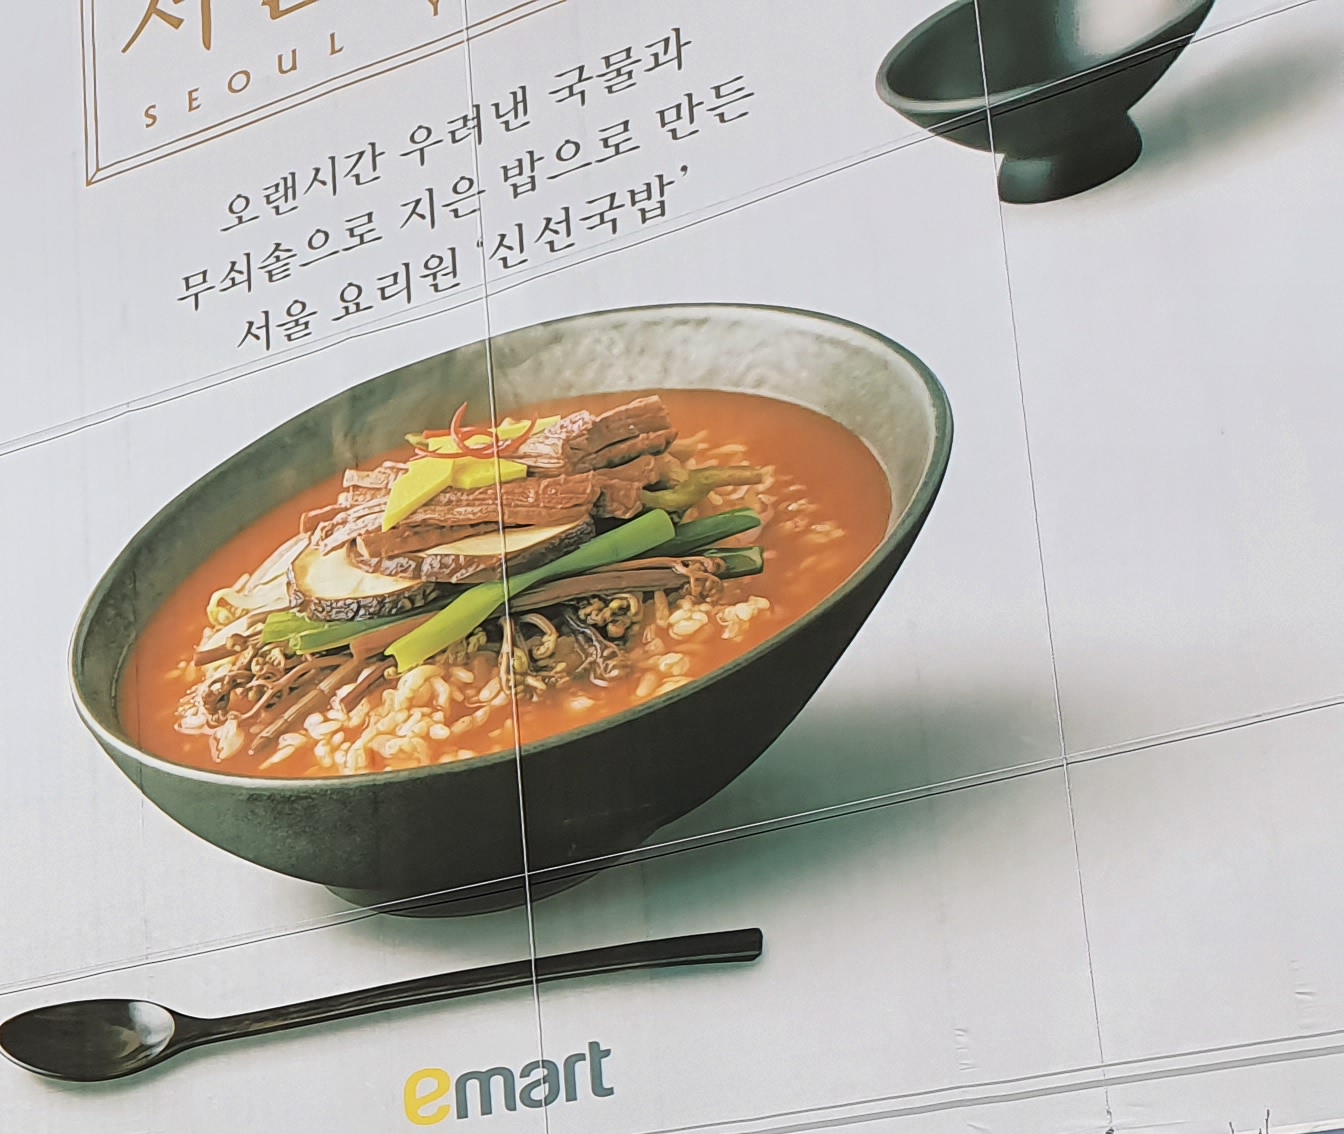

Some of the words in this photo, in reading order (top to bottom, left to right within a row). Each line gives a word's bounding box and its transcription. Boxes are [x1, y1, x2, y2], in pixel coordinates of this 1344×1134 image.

[143, 32, 345, 129] SEOUL
[219, 142, 386, 233] 오랜시간
[399, 85, 530, 167] 우려낸
[547, 27, 693, 106] 국물과
[176, 211, 384, 312] 무쇠솥으로
[400, 174, 486, 232] 지은
[501, 119, 642, 201] 밥으로
[656, 74, 755, 141] 만든
[236, 299, 318, 352] 서울
[331, 246, 459, 323] 요리원
[404, 1040, 615, 1126] emart
